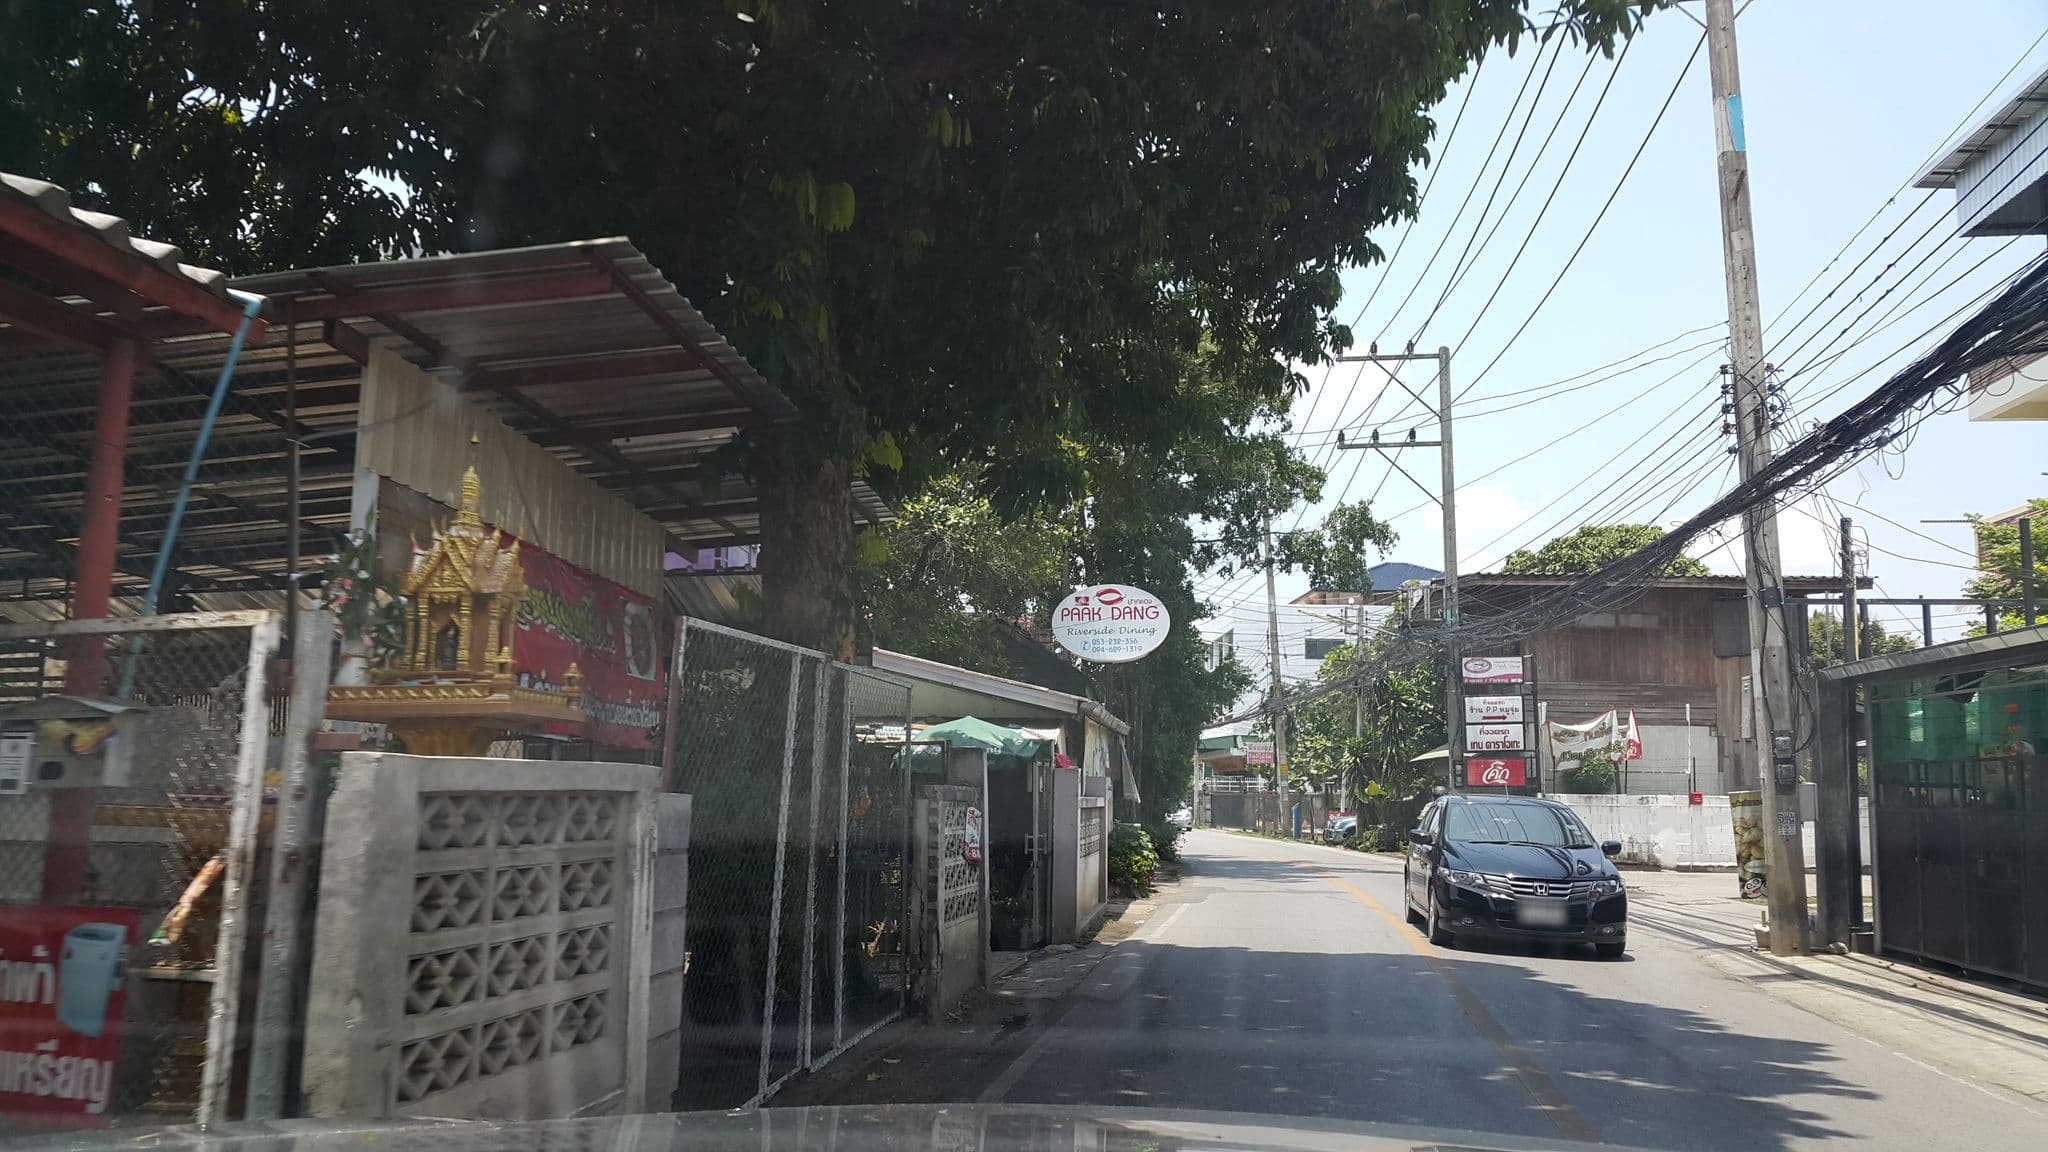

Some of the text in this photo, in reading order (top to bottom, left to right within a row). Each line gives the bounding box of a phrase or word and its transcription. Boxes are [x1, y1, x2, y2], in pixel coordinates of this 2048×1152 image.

[1061, 605, 1159, 622] PAAK DANG
[1067, 625, 1157, 636] Riverside Dining
